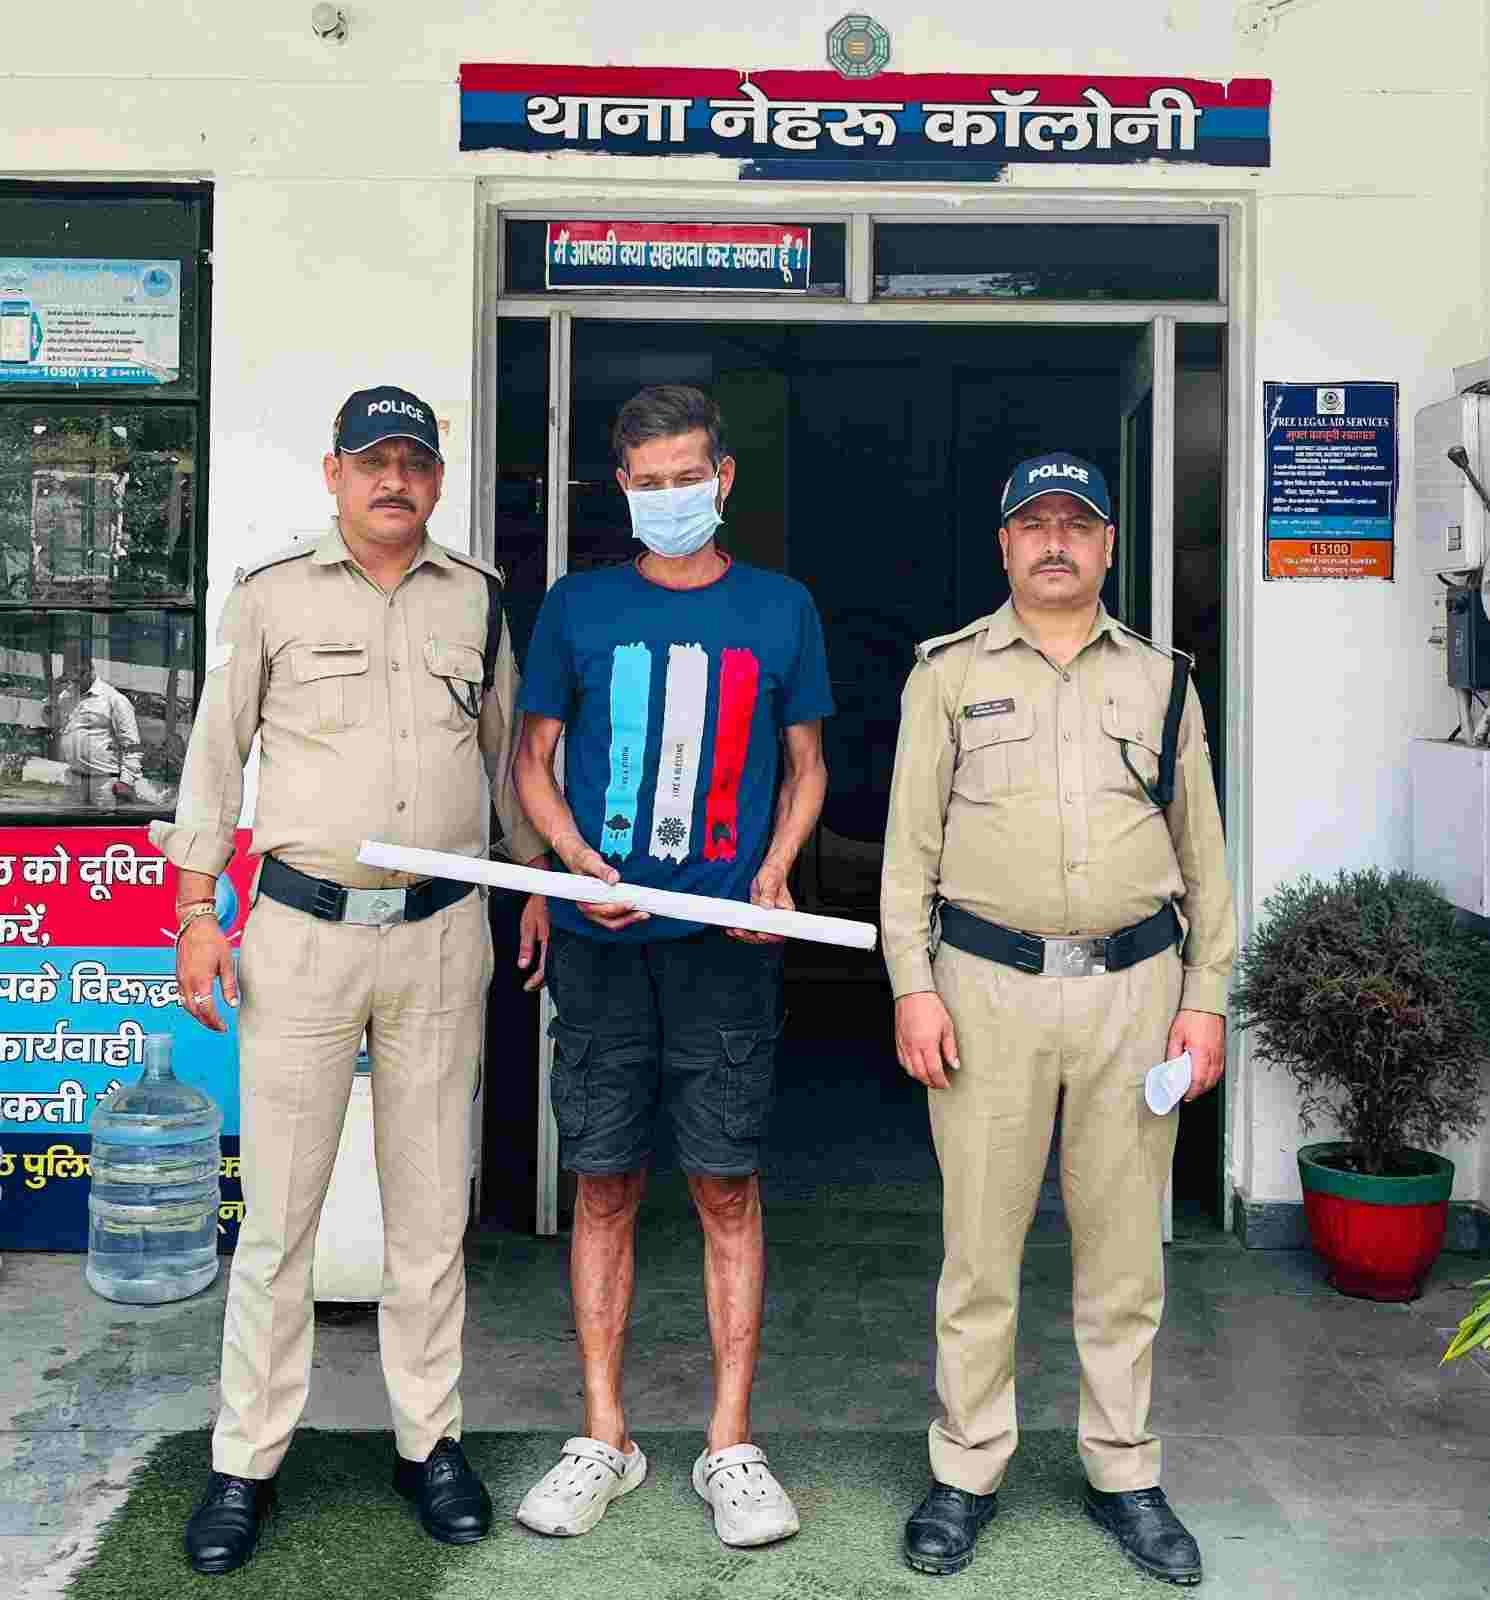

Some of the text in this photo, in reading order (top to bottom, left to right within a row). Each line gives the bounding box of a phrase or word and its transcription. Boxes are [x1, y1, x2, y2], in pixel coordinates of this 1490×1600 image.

[527, 82, 1203, 151] थाना नेहरू कॉलोनी
[570, 229, 618, 266] आपकी
[620, 240, 647, 267] क्या
[649, 241, 704, 270] सहायता
[706, 242, 732, 268] कर
[733, 243, 778, 269] सकता
[42, 367, 108, 378] 1090/112
[367, 399, 426, 424] POLICE
[1298, 416, 1327, 427] LEGAL
[1346, 416, 1390, 427] SERVICES
[1028, 463, 1089, 484] POLICE
[1311, 543, 1350, 554] 15100
[22, 844, 71, 885] को
[78, 843, 168, 901] दूषित
